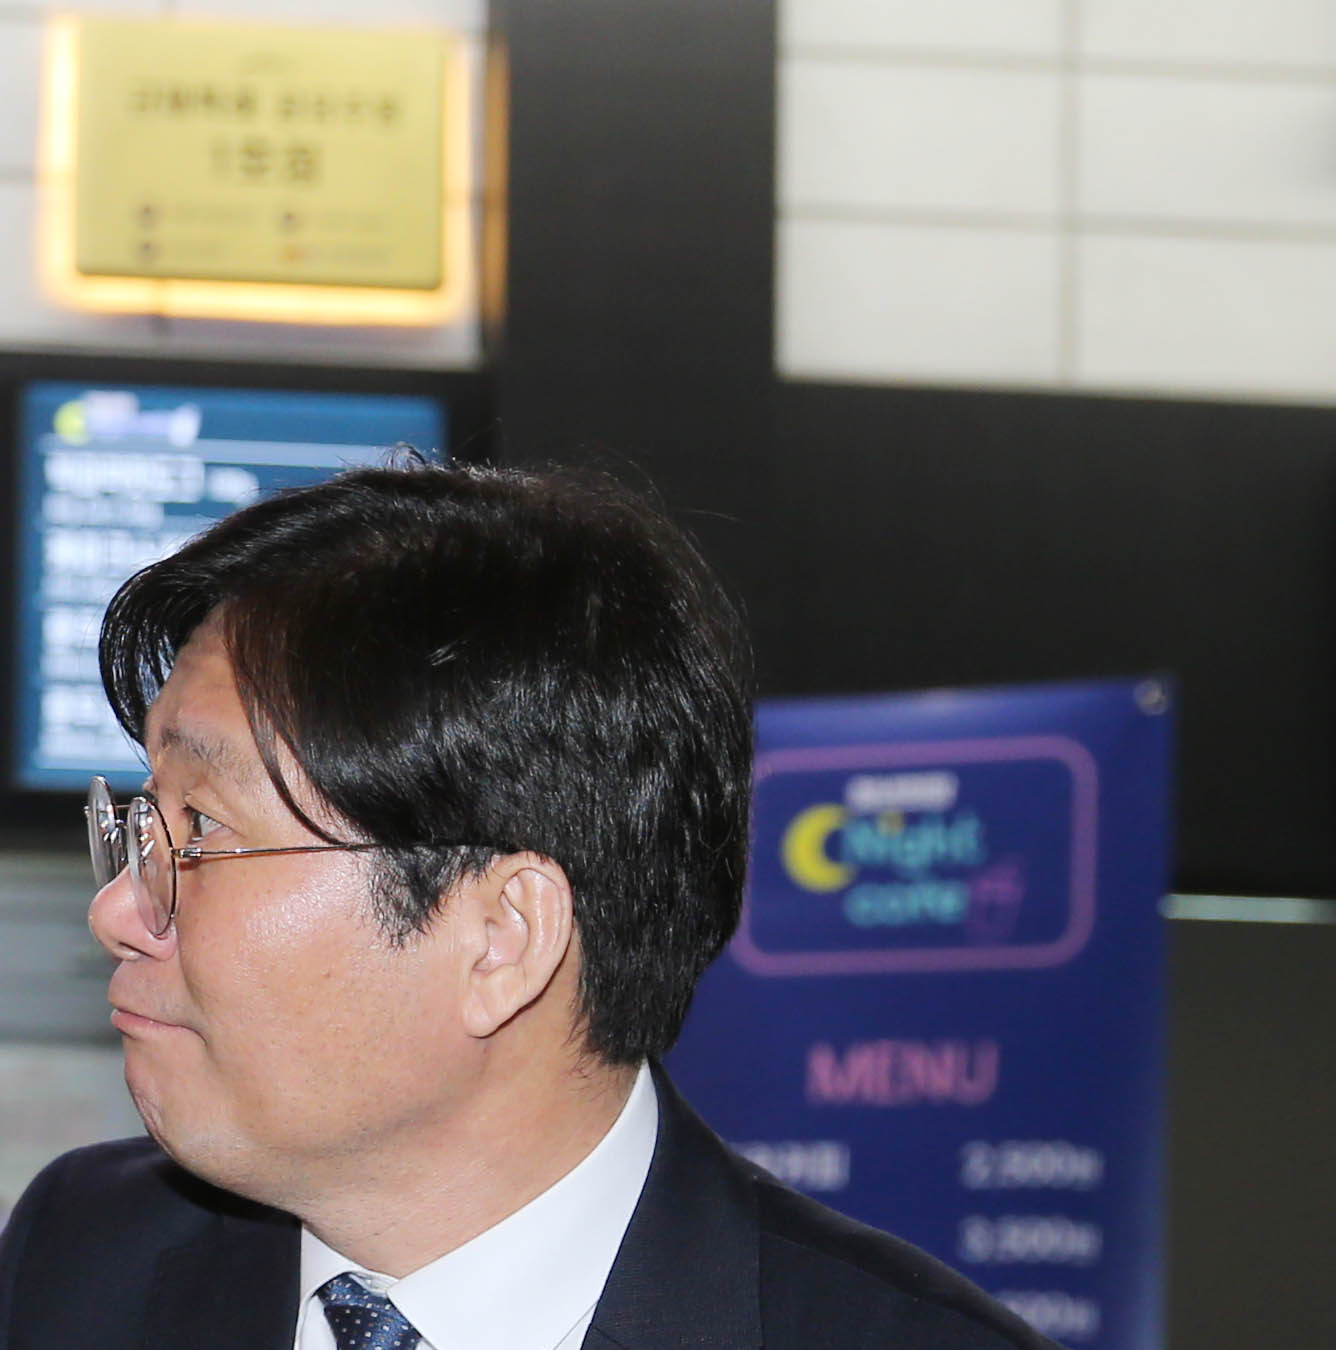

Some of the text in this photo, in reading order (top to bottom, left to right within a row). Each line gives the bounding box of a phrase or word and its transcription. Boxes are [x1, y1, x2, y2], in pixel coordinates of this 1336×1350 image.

[843, 811, 982, 868] Night
[846, 882, 968, 924] cafe
[808, 1042, 999, 1105] MENU
